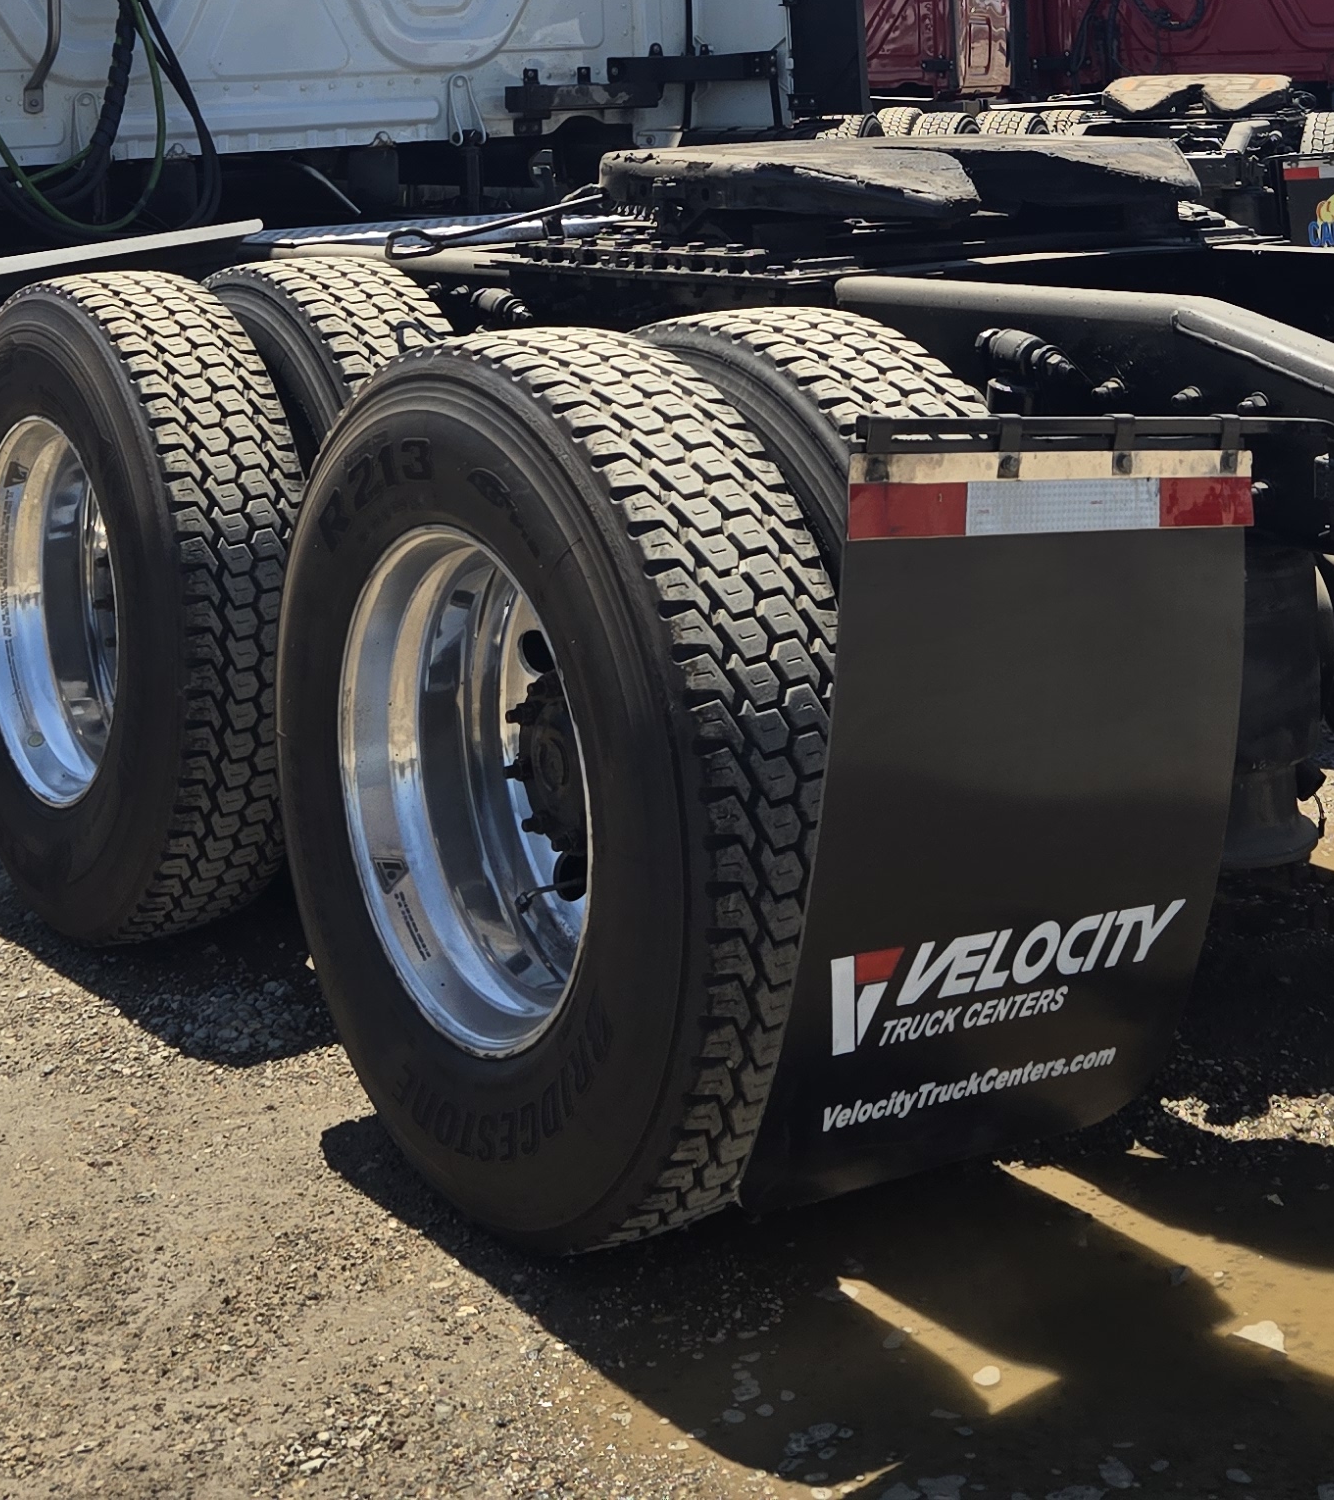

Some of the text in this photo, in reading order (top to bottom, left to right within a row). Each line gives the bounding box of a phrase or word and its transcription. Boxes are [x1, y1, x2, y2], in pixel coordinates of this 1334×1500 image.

[896, 898, 1186, 1006] VELOCITY
[878, 985, 1069, 1047] TRUCK CENTERS
[821, 1046, 1117, 1133] VelocityTruckCenters.com
